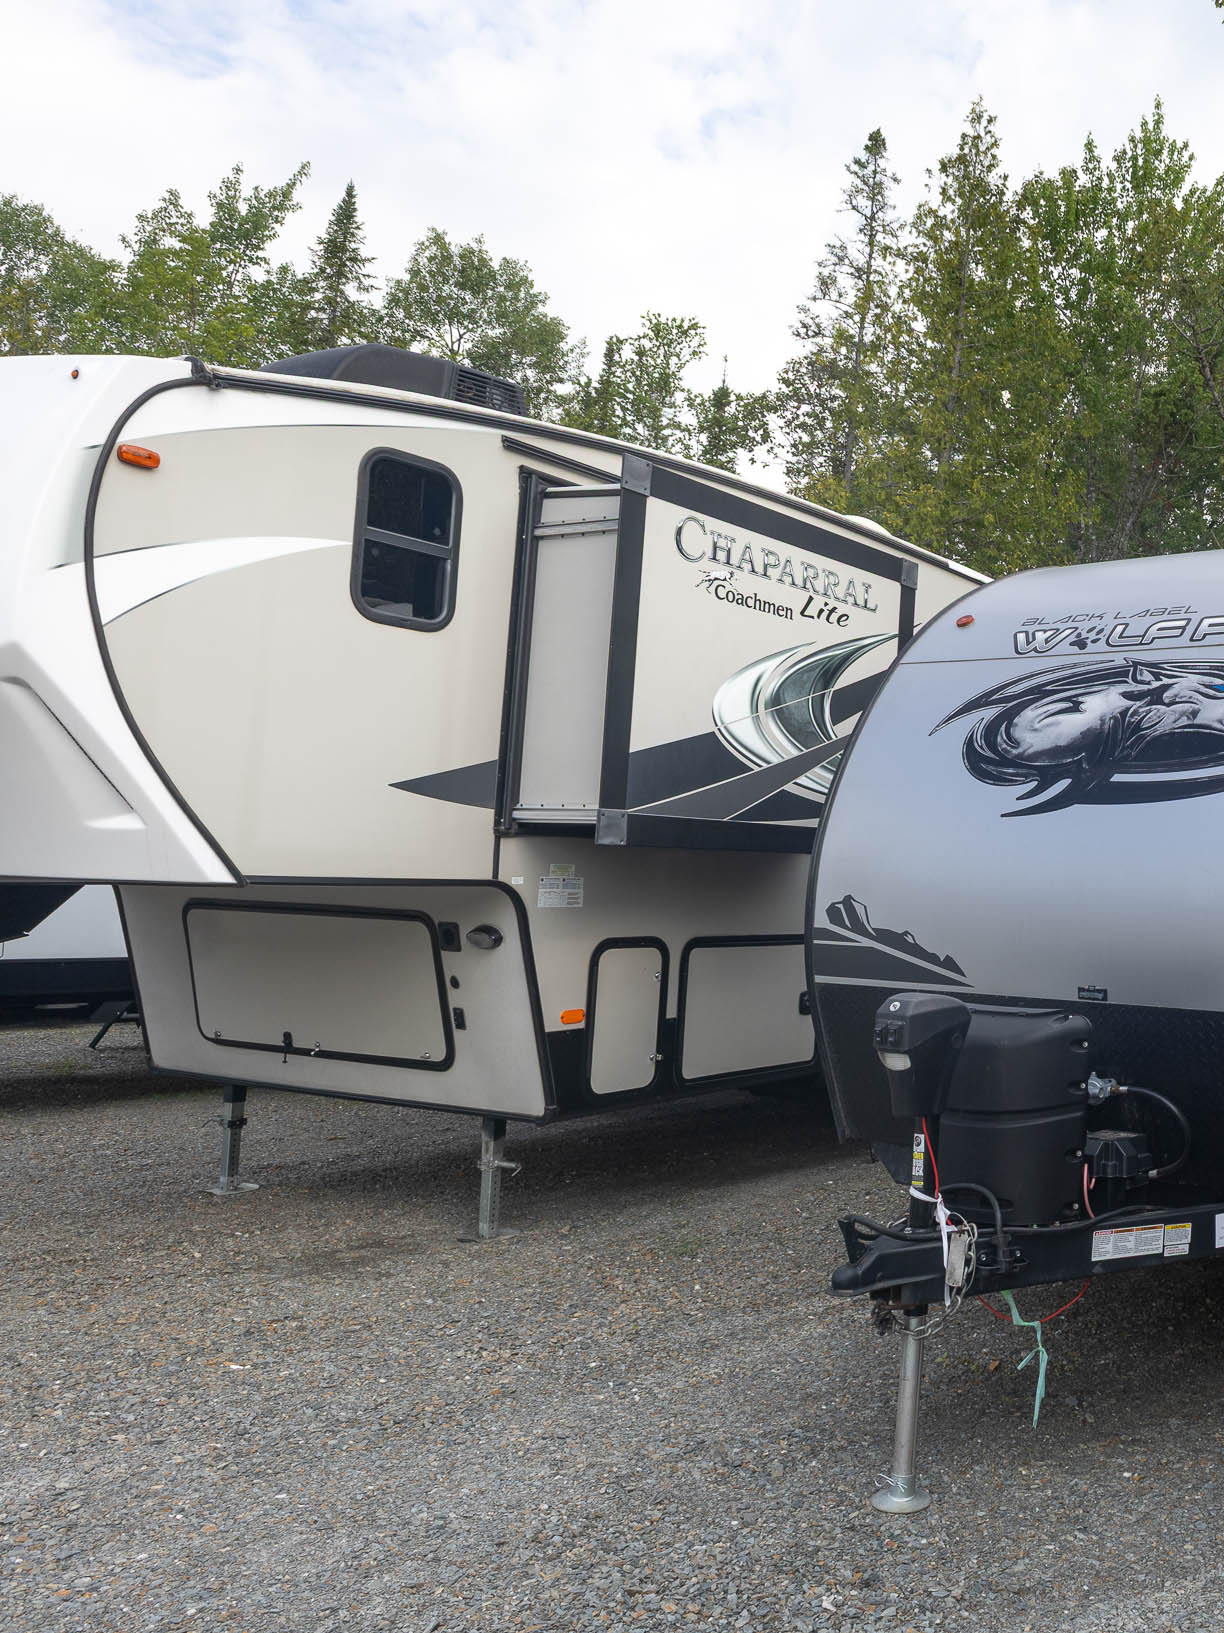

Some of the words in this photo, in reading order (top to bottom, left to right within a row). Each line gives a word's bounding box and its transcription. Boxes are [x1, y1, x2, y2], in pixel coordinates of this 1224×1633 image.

[674, 515, 878, 613] CHAPARRAL
[714, 584, 794, 621] Coachmen
[800, 594, 850, 628] Lite
[1021, 611, 1107, 626] BLACK
[1113, 605, 1198, 620] LABEL
